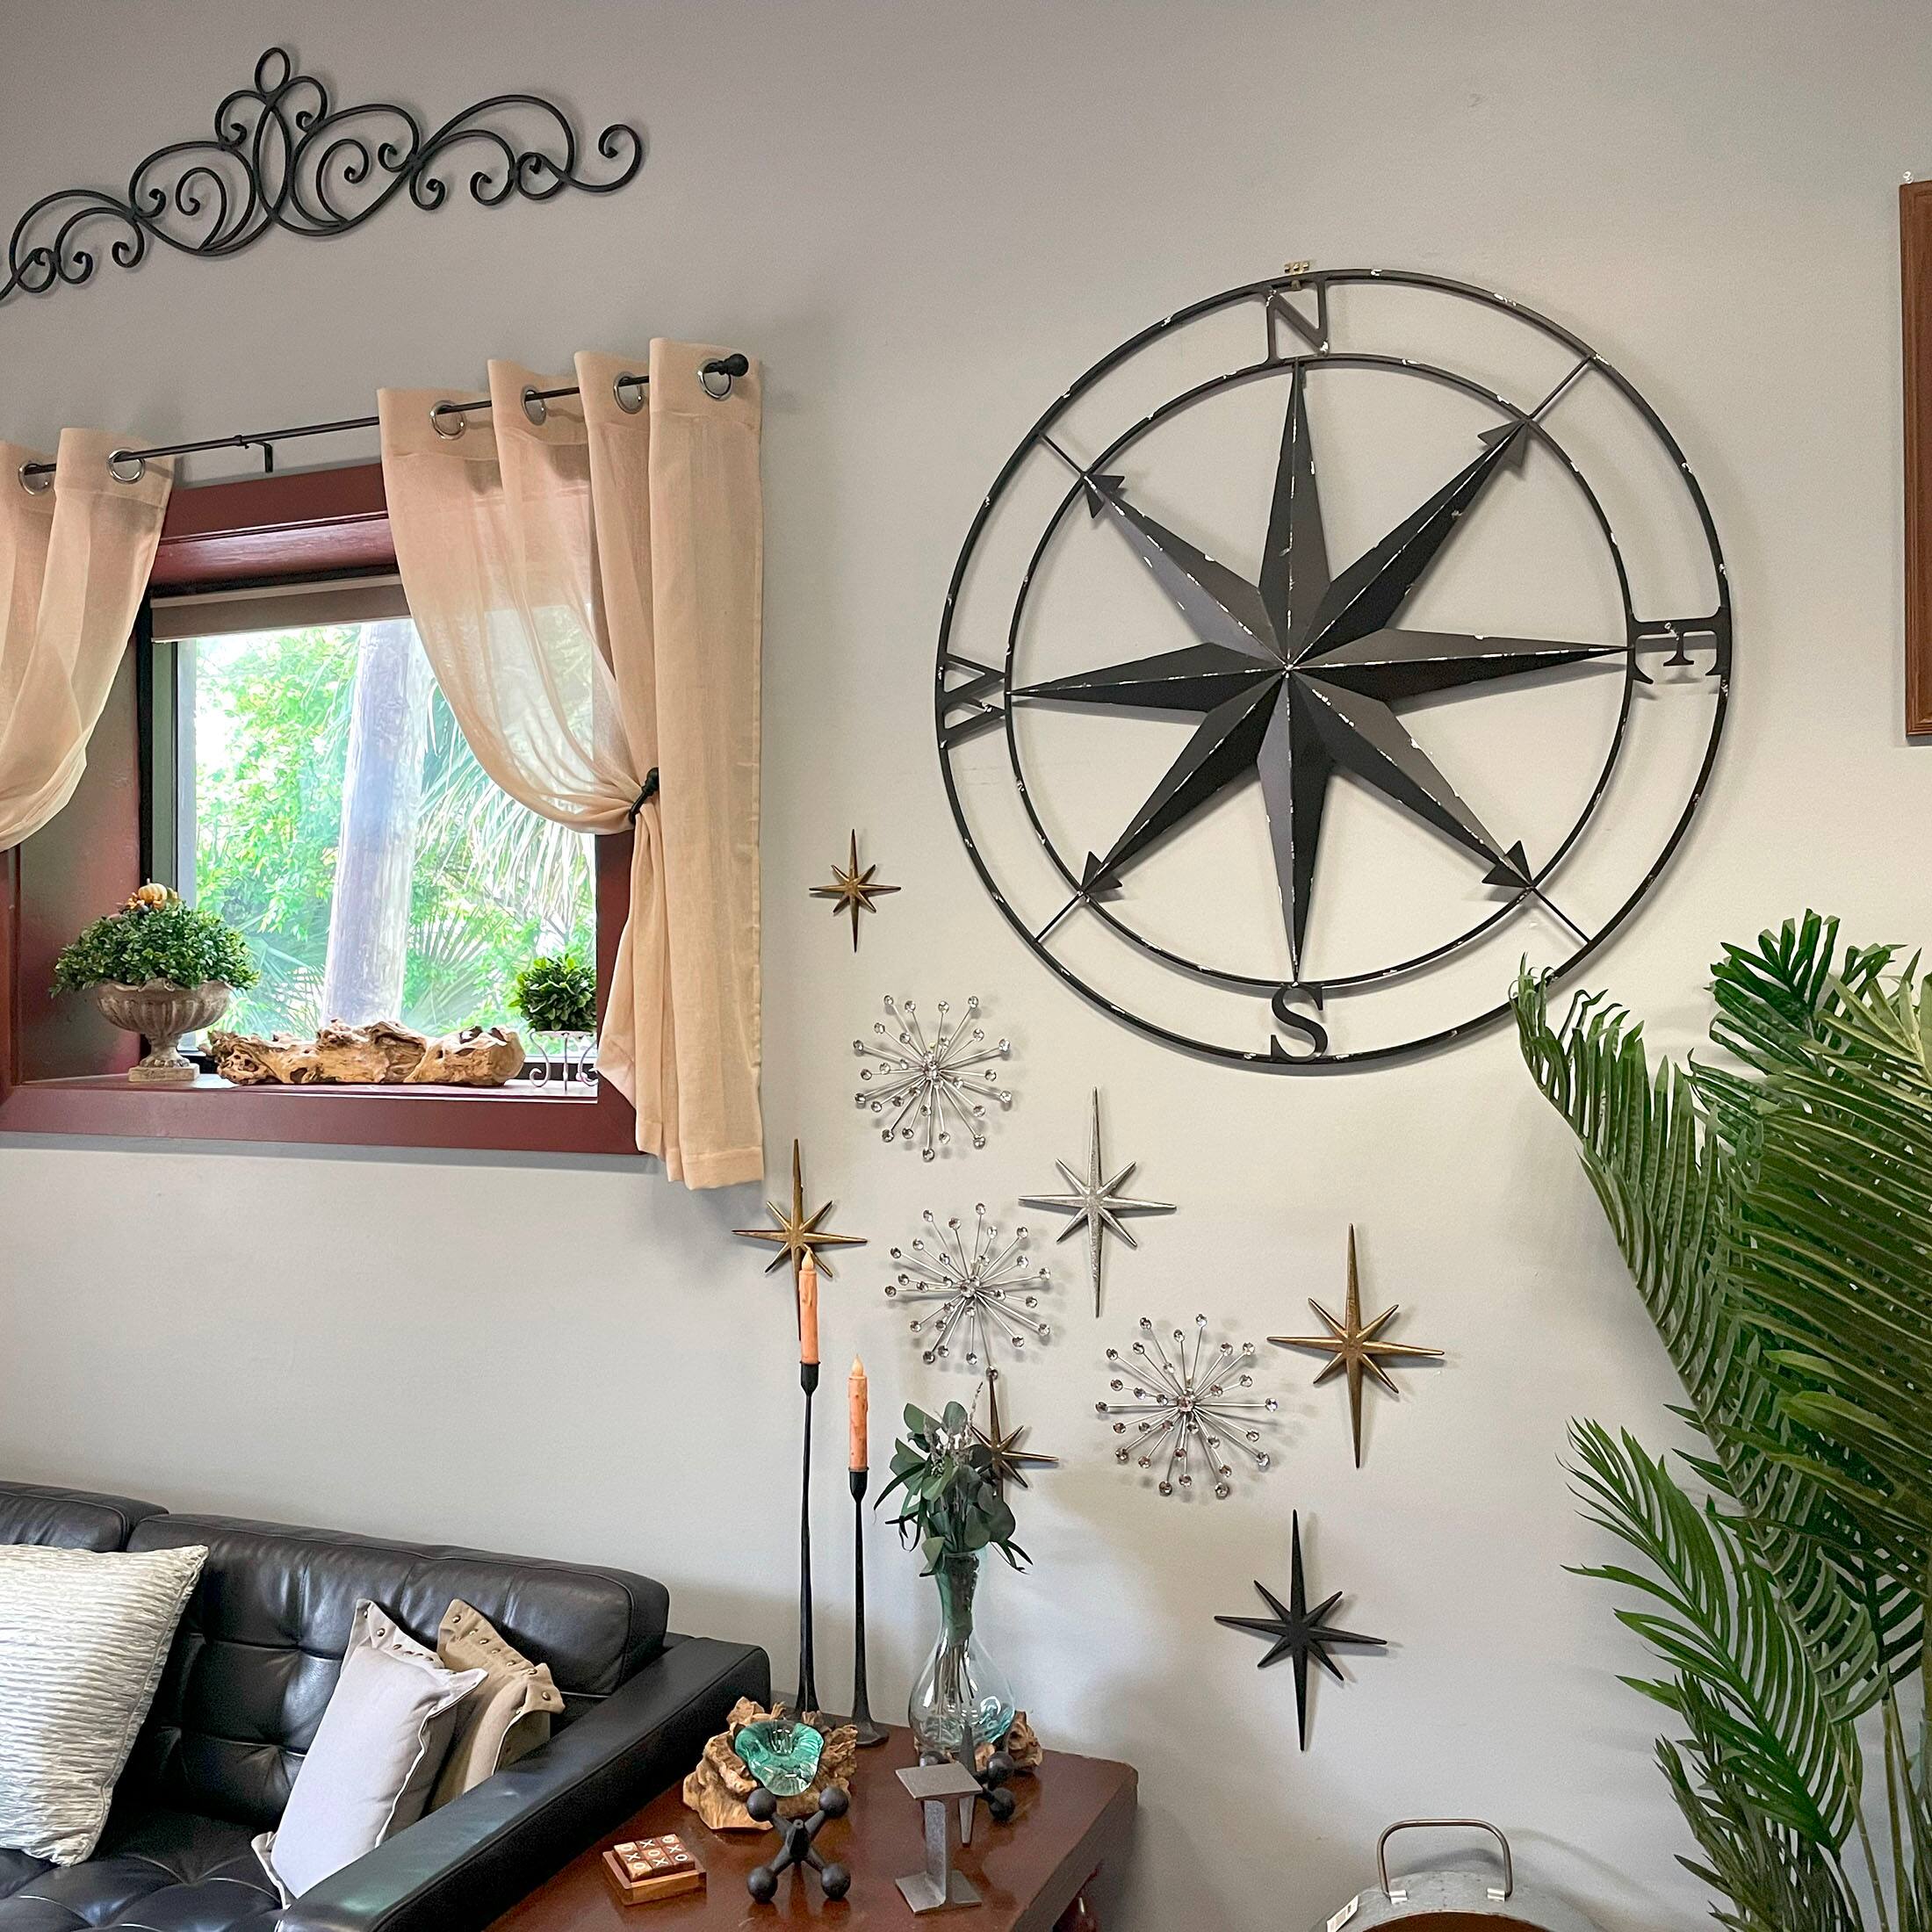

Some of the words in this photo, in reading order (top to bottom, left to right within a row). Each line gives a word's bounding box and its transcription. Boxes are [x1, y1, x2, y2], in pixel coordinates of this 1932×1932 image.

[1263, 275, 1329, 362] N
[1627, 606, 1731, 684] E
[935, 652, 1007, 747] W
[1270, 983, 1328, 1063] S
[626, 1852, 641, 1862] X
[667, 1844, 682, 1853] X
[652, 1857, 668, 1866] X
